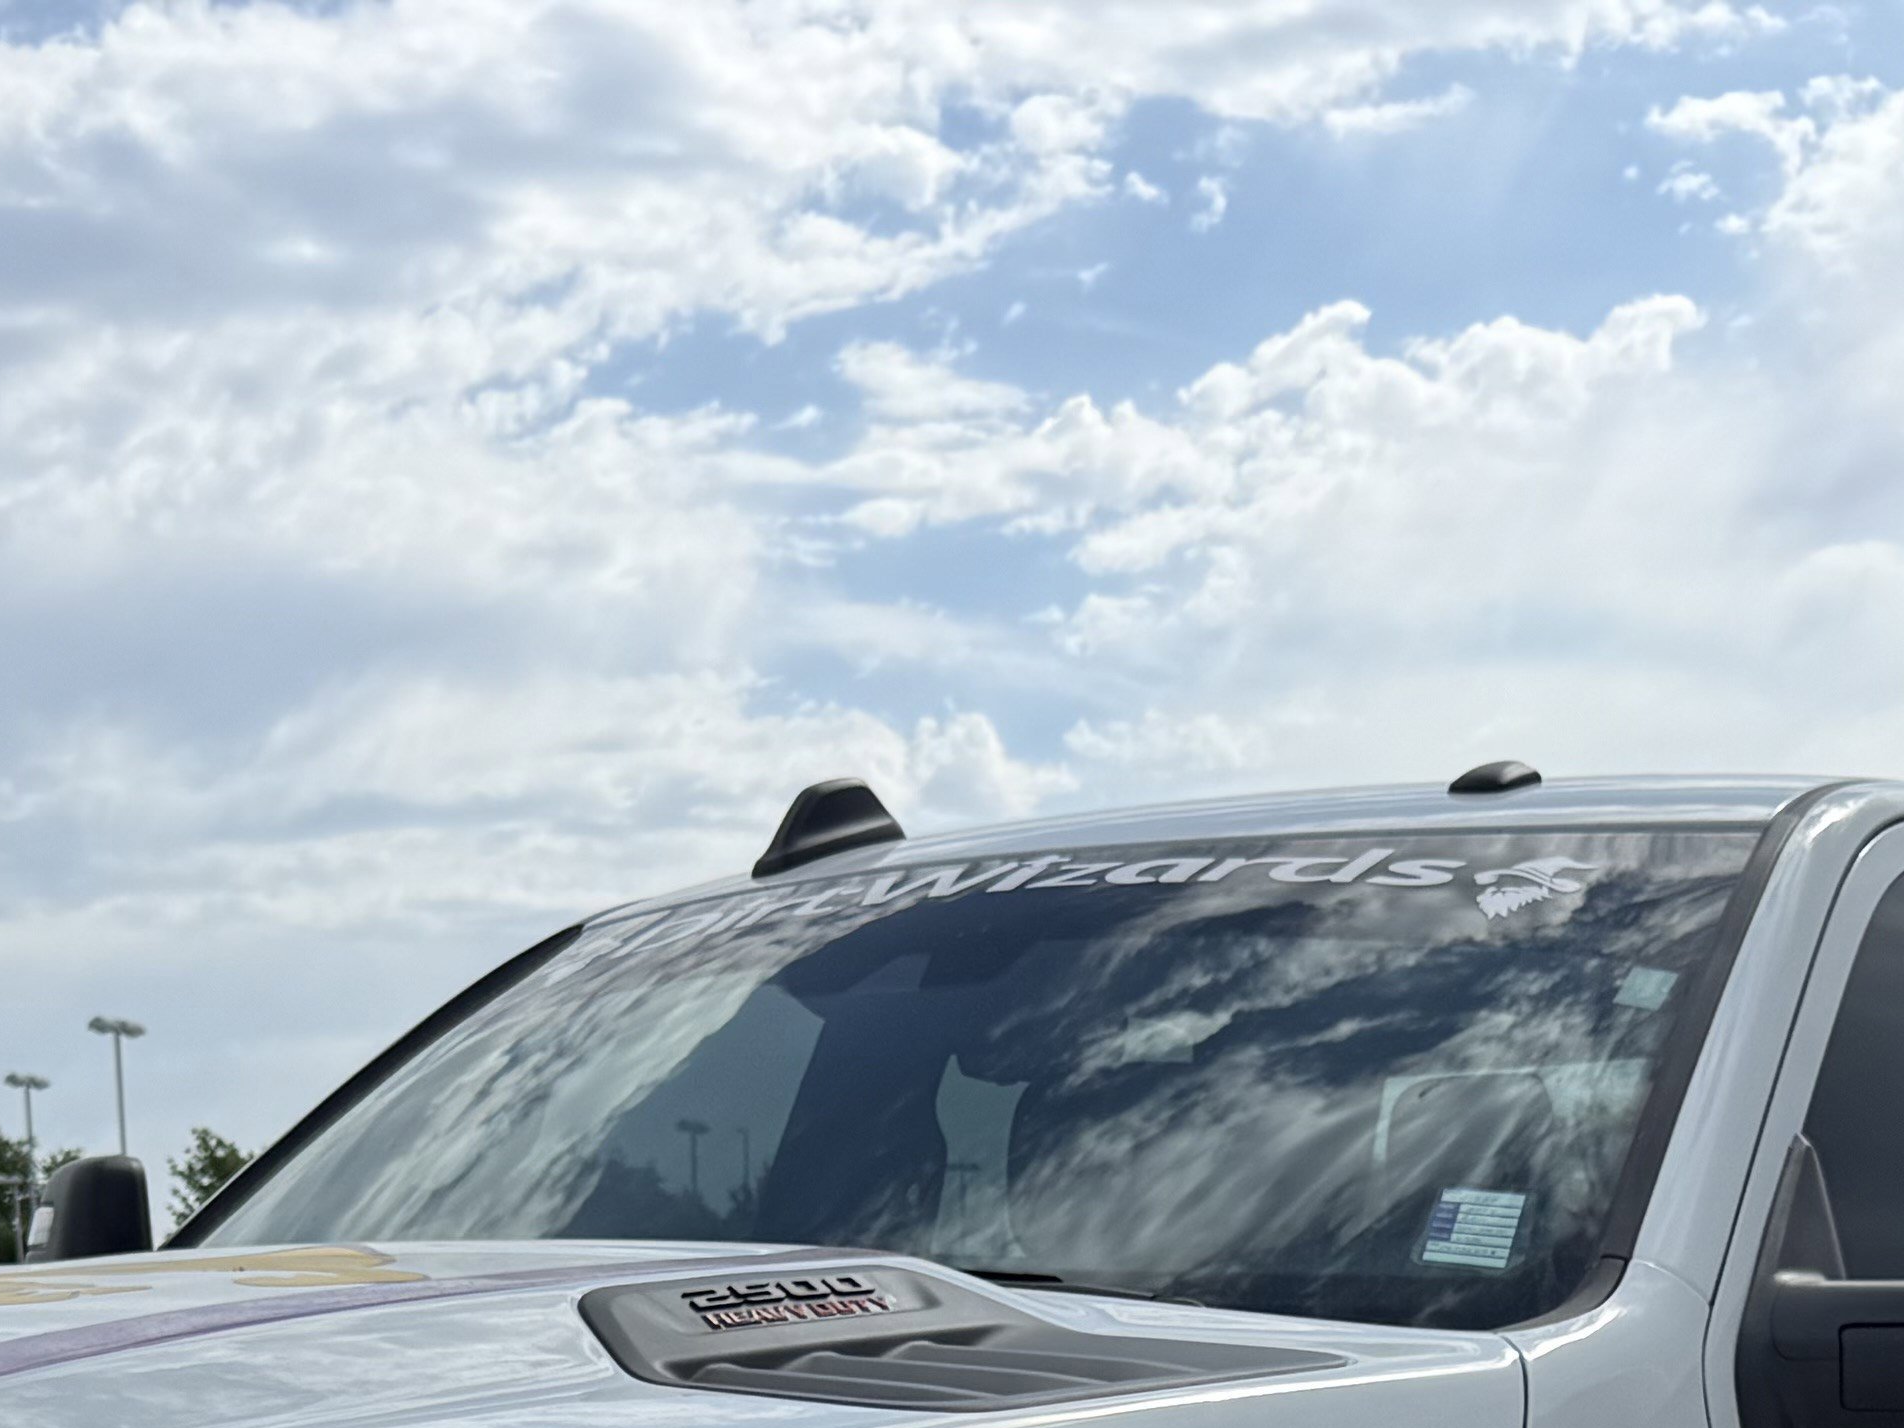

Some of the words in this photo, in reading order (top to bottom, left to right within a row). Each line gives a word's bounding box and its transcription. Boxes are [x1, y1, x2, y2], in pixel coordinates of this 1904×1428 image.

[680, 1273, 876, 1312] 2500
[701, 1302, 808, 1331] HEAVY
[805, 1295, 897, 1319] DUTY
